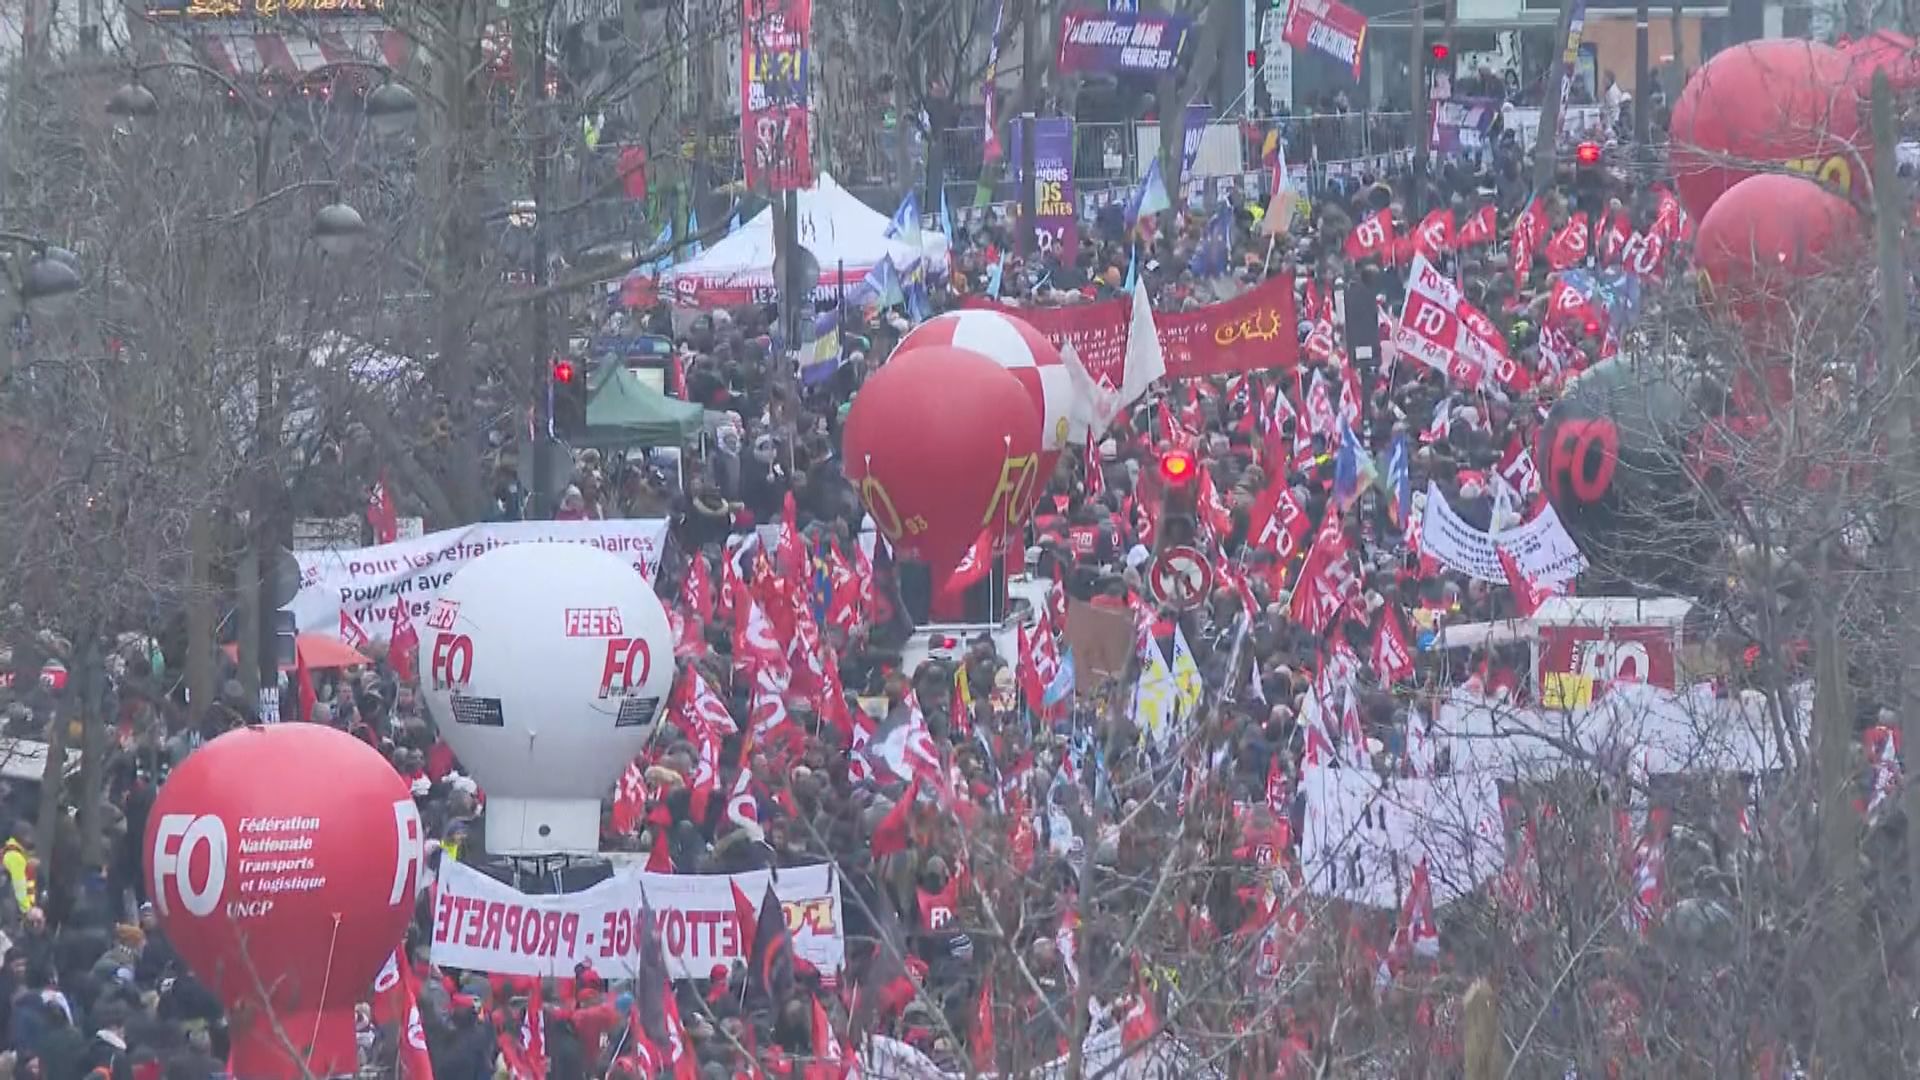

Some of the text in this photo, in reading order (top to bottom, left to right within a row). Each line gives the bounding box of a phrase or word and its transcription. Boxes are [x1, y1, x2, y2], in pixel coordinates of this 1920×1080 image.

[1413, 302, 1447, 336] FO
[1547, 417, 1617, 503] FO
[983, 452, 1039, 527] FO
[349, 559, 399, 578] Pour
[340, 583, 390, 603] Pour
[566, 607, 622, 636] FEETS
[432, 633, 473, 691] FO
[599, 638, 651, 699] FO
[238, 816, 320, 833] Fédération
[238, 834, 313, 854] Nationale
[153, 812, 229, 917] FO
[239, 857, 315, 875] Transports
[240, 876, 326, 895] et logistique
[226, 900, 273, 918] UNCP
